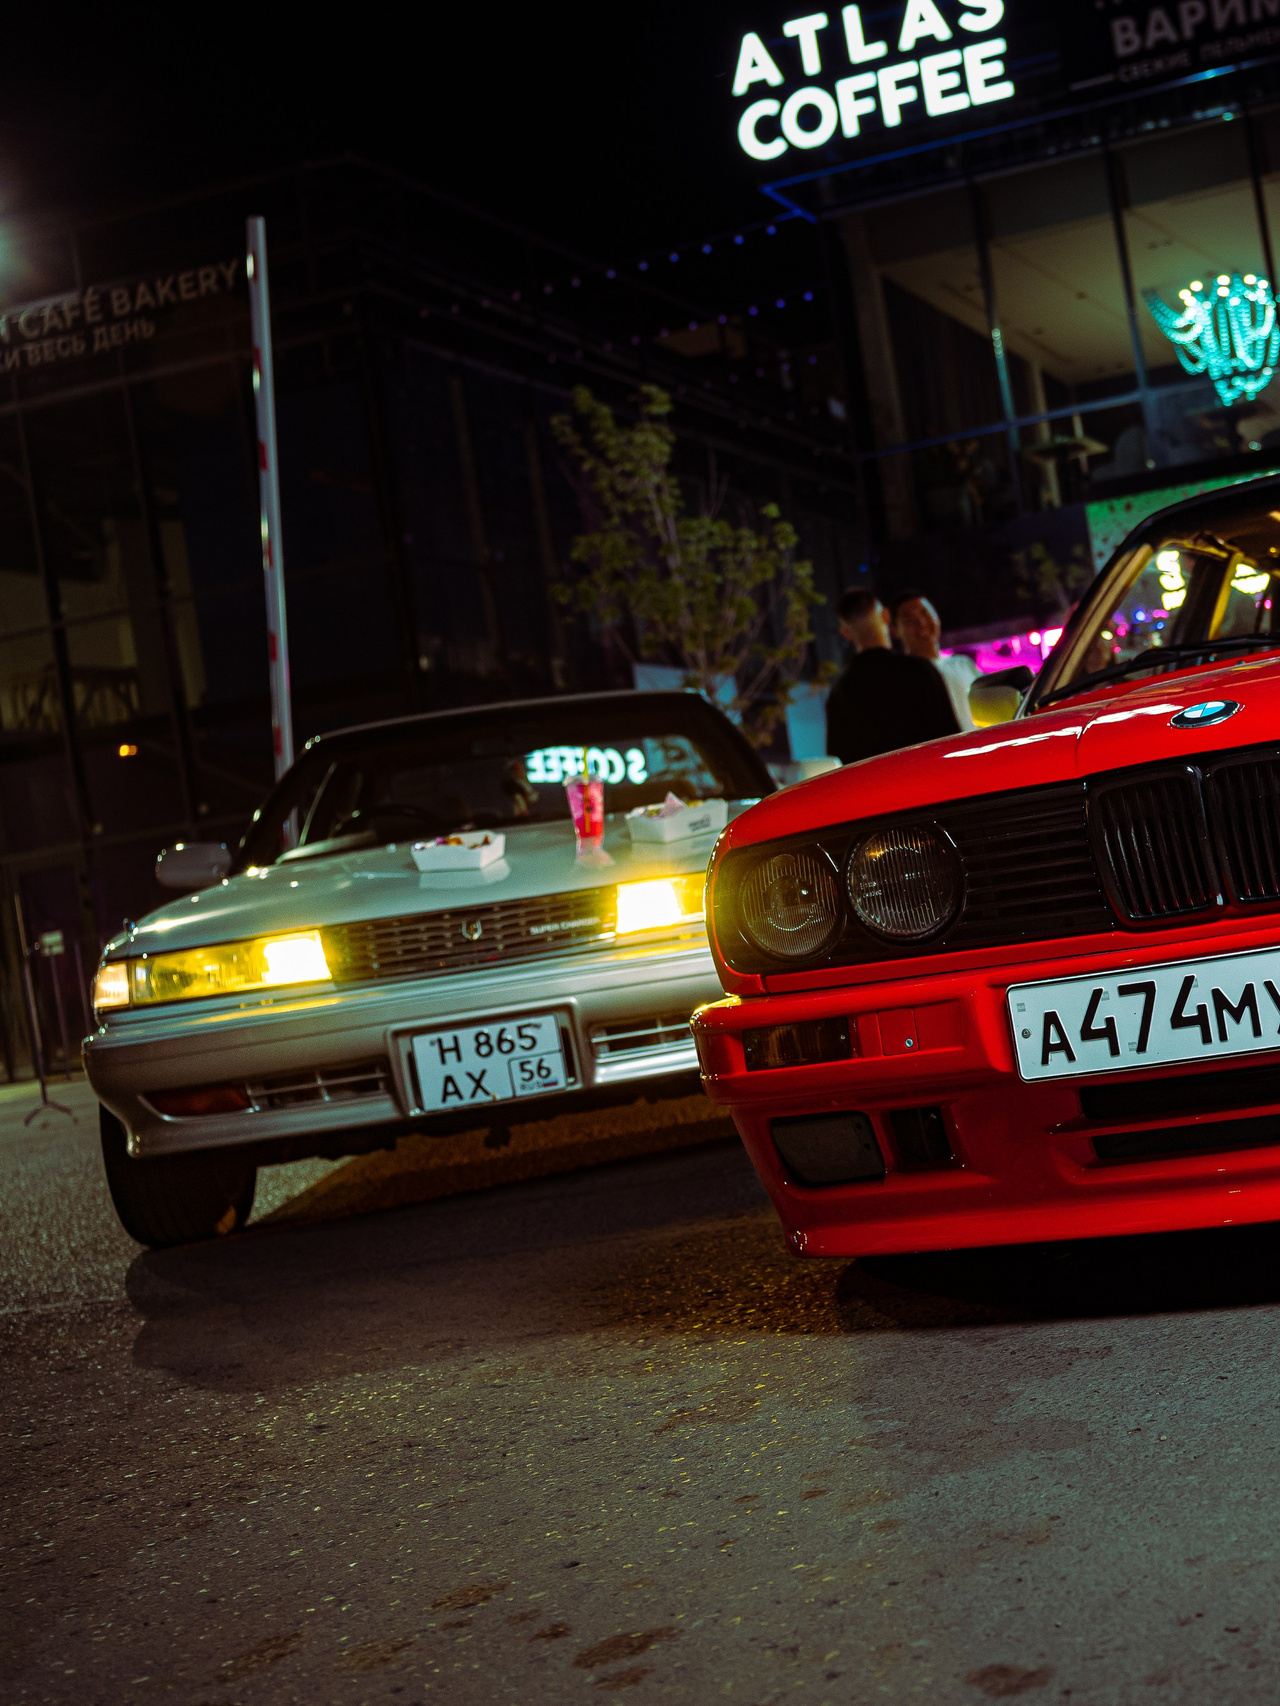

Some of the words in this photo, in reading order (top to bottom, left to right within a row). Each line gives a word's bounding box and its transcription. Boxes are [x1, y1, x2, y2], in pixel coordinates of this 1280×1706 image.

[731, 0, 1005, 97] ATLAS
[737, 38, 1015, 161] COFFEE
[18, 286, 102, 340] CAFÉ
[110, 259, 240, 318] BAKERY
[26, 333, 87, 367] ВЕСЬ
[93, 316, 157, 355] ДЕНЬ
[474, 1023, 538, 1058] 865
[519, 1057, 552, 1082] 56
